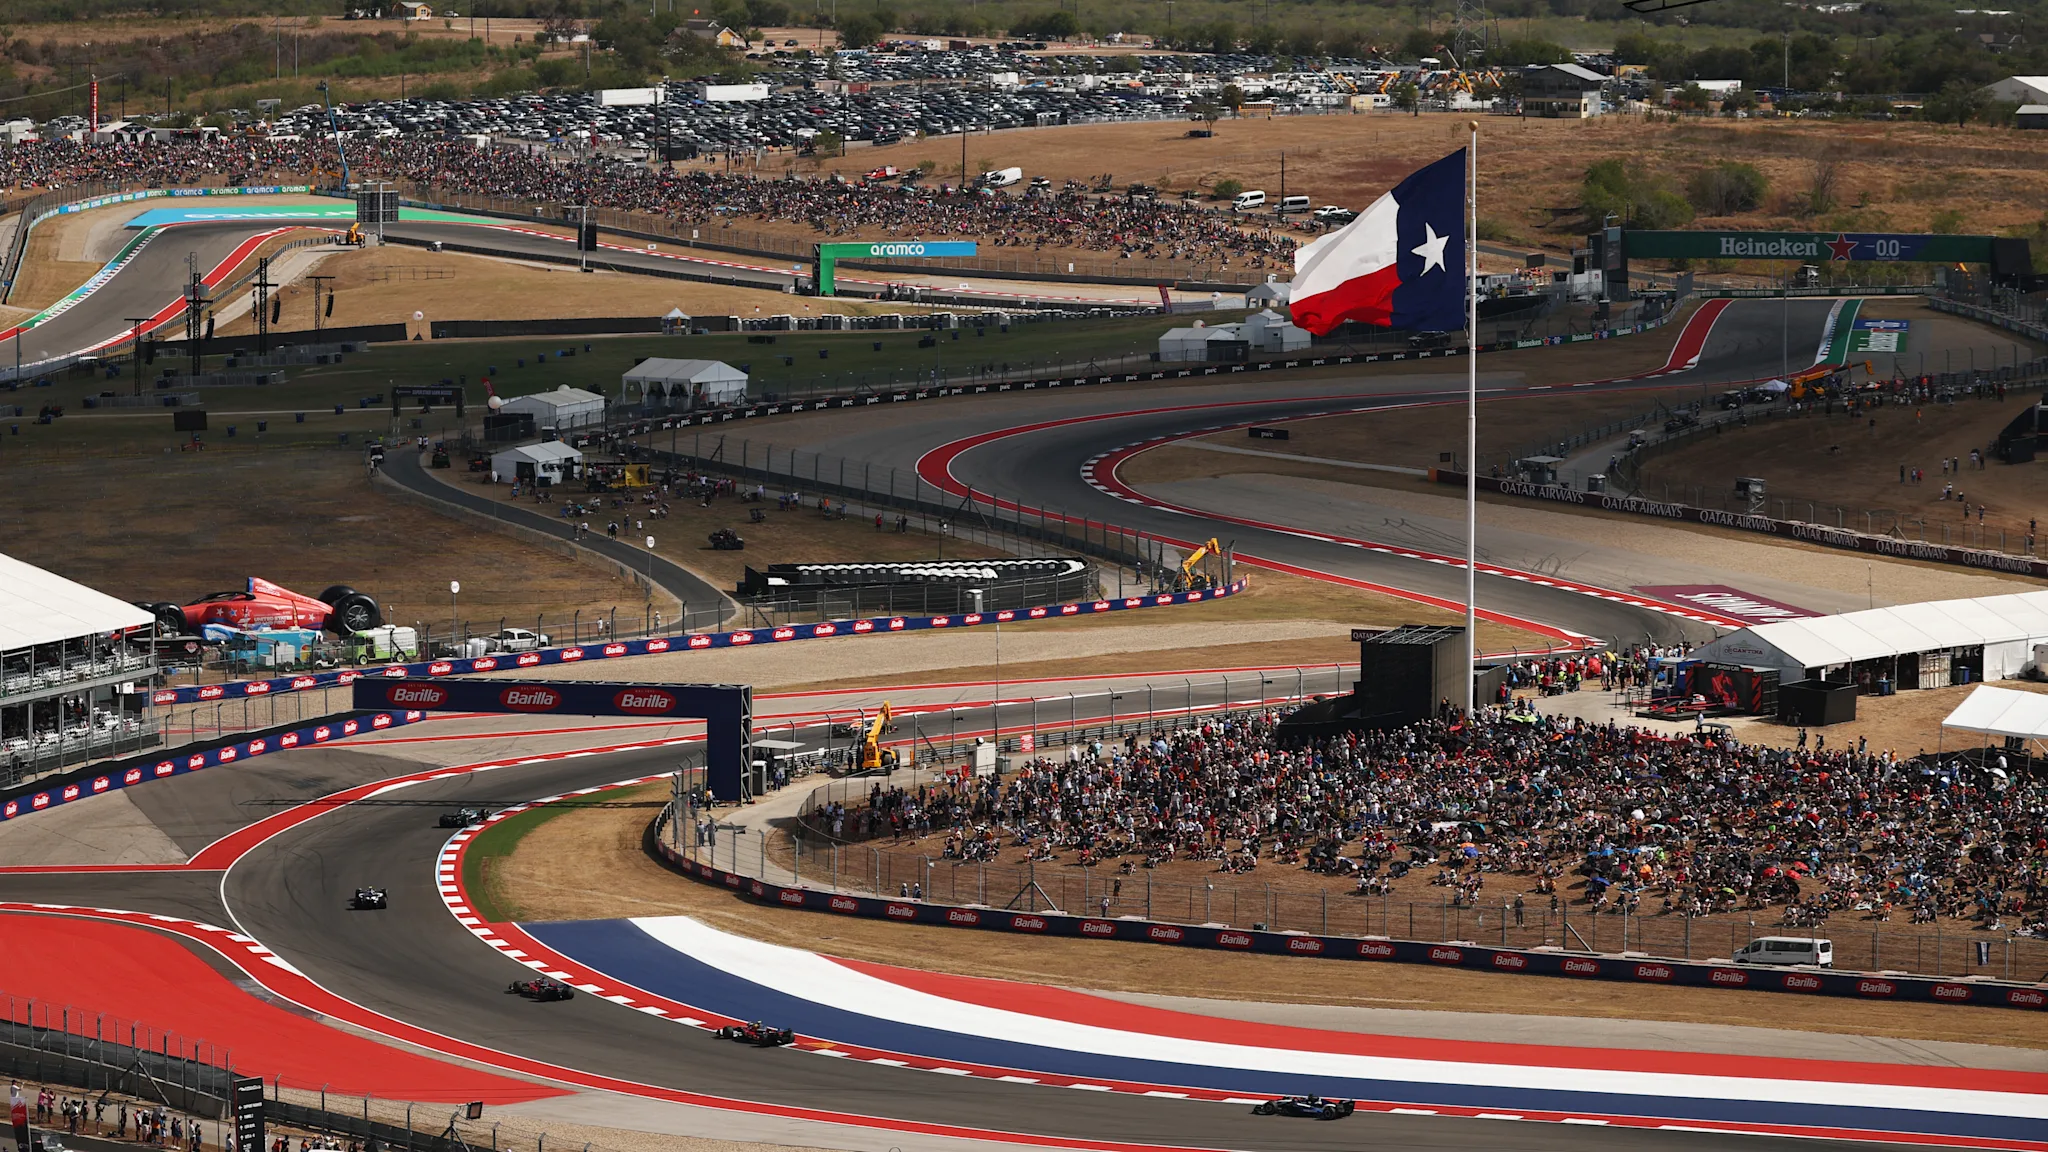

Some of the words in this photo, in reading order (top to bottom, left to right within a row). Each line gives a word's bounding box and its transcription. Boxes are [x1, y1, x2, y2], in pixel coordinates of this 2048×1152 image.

[870, 244, 924, 255] aramco
[1720, 237, 1818, 256] Heineken
[1876, 240, 1900, 256] 0.0
[1500, 481, 1536, 496] QATAR
[1539, 486, 1584, 504] AIRWAYS
[1602, 496, 1636, 512] QATAR
[1640, 502, 1682, 518] AIRWAYS
[1700, 511, 1734, 526] QATAR
[1736, 516, 1776, 532] AIRWAYS
[1792, 525, 1821, 540] QATAR
[1824, 530, 1860, 548] AIRWAYS
[1876, 541, 1907, 556] QATAR
[1910, 545, 1948, 560] AIRWAYS
[1963, 552, 1994, 568] QATAR
[1996, 557, 2032, 573] AIRWAYS
[648, 642, 667, 650] Barilla
[691, 638, 709, 646] Barilla
[562, 650, 582, 659] Barilla
[605, 646, 625, 654] Barilla
[475, 660, 495, 669] Barilla
[520, 656, 538, 664] Barilla
[430, 665, 450, 674] Barilla
[248, 684, 269, 693] Barilla
[294, 680, 314, 688] Barilla
[156, 693, 175, 702] Barilla
[201, 688, 222, 697] Barilla
[394, 689, 440, 702] Barilla
[507, 692, 552, 705] Barilla
[621, 694, 668, 708] Barilla
[781, 892, 802, 903] Barilla
[832, 899, 856, 910] Barilla
[888, 906, 914, 917] Barilla
[950, 912, 978, 923] Barilla
[1014, 918, 1044, 929] Barilla
[1083, 922, 1112, 934] Barilla
[1151, 928, 1180, 940] Barilla
[1220, 934, 1249, 946] Barilla
[1290, 940, 1320, 950] Barilla
[1361, 945, 1391, 956] Barilla
[1432, 950, 1460, 960] Barilla
[1495, 955, 1523, 967] Barilla
[1565, 962, 1596, 972] Barilla
[1638, 967, 1669, 978] Barilla
[1712, 972, 1744, 983] Barilla
[1787, 976, 1818, 988] Barilla
[1860, 982, 1892, 994] Barilla
[1936, 986, 1968, 998] Barilla
[2010, 991, 2043, 1004] Barilla
